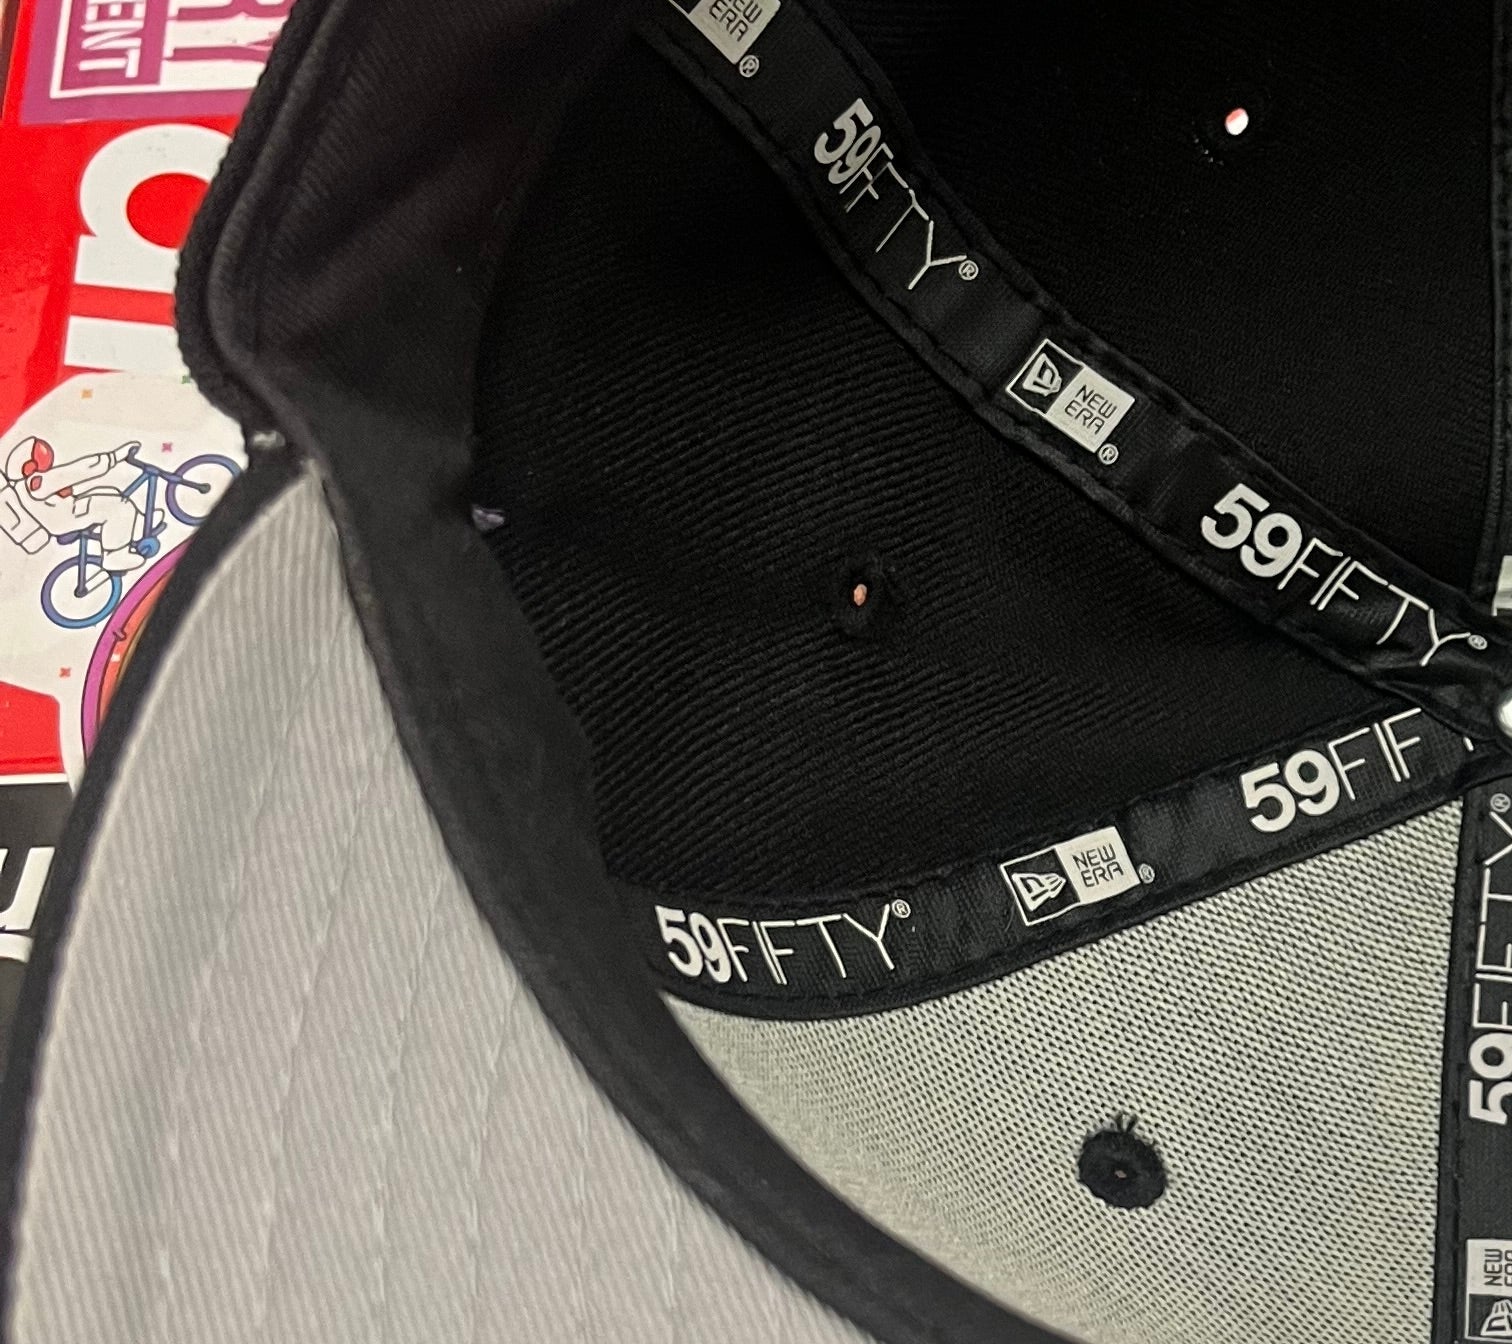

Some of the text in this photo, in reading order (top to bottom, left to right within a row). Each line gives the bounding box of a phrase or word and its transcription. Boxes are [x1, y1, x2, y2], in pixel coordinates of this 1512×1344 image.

[1064, 400, 1105, 435] ERA
[1076, 384, 1119, 419] NEW
[1201, 483, 1471, 666] 59FIFTY
[1239, 707, 1421, 833] 59FIF
[1073, 843, 1117, 871] NEW
[1079, 862, 1125, 889] ERA
[655, 903, 895, 986] 59FIFTY
[1483, 1248, 1504, 1287] NEW
